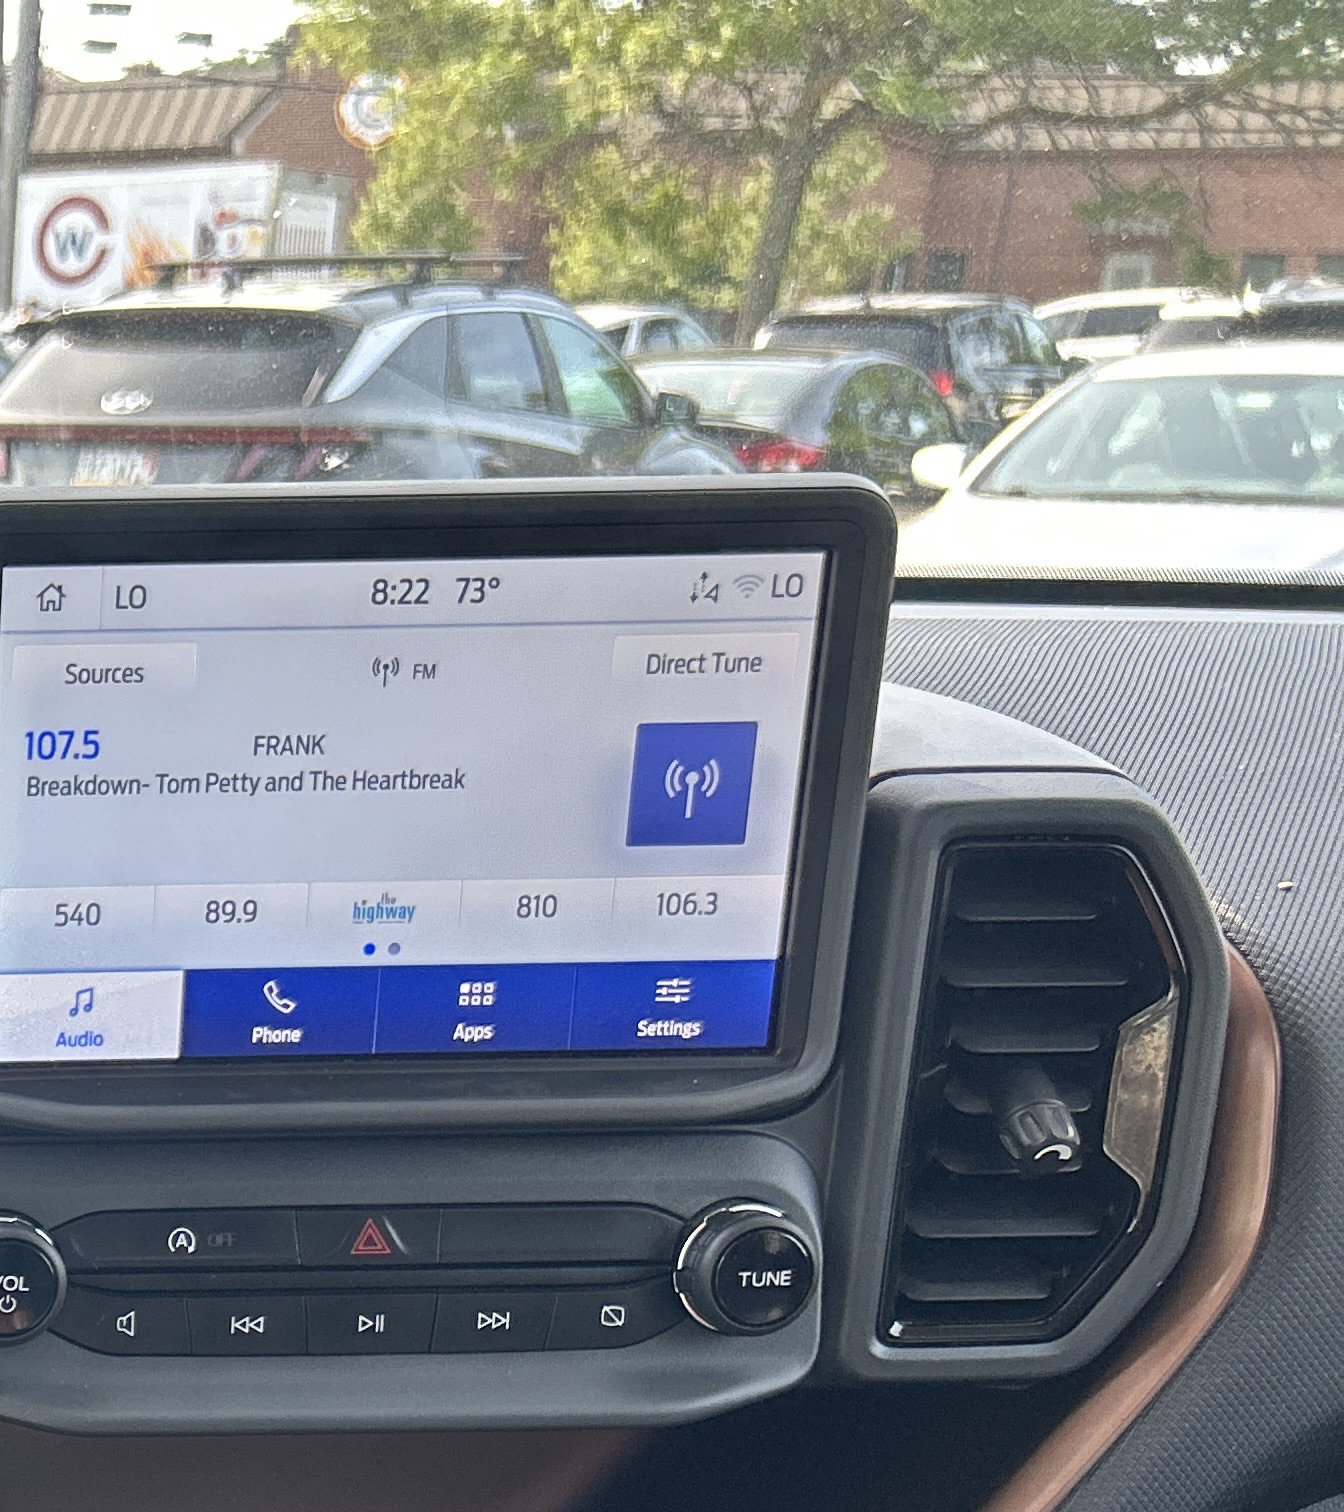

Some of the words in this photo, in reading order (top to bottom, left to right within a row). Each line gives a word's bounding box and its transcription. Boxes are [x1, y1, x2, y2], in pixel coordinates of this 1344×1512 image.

[116, 585, 146, 609] LO
[372, 578, 429, 605] 8:22
[456, 577, 500, 603] 73°
[772, 574, 803, 598] LO
[65, 664, 144, 684] Sources
[413, 664, 436, 679] FM
[647, 654, 706, 674] Direct
[712, 652, 762, 673] Tune
[26, 730, 99, 760] 107.5
[254, 735, 325, 756] FRANK
[27, 774, 149, 796] Breakdown-
[155, 774, 200, 794] Tom
[206, 773, 261, 796] Petty
[265, 771, 304, 792] and
[309, 770, 346, 791] The
[352, 768, 465, 790] Heartbreak
[55, 903, 100, 926] 540
[206, 900, 257, 923] 89.9
[353, 899, 415, 924] highway
[517, 894, 557, 918] 810
[657, 892, 718, 915] 106.3
[56, 1031, 103, 1047] Audio
[251, 1027, 302, 1043] Phone
[453, 1023, 493, 1042] Apps
[637, 1020, 701, 1038] Settings
[739, 1270, 791, 1287] TUNE
